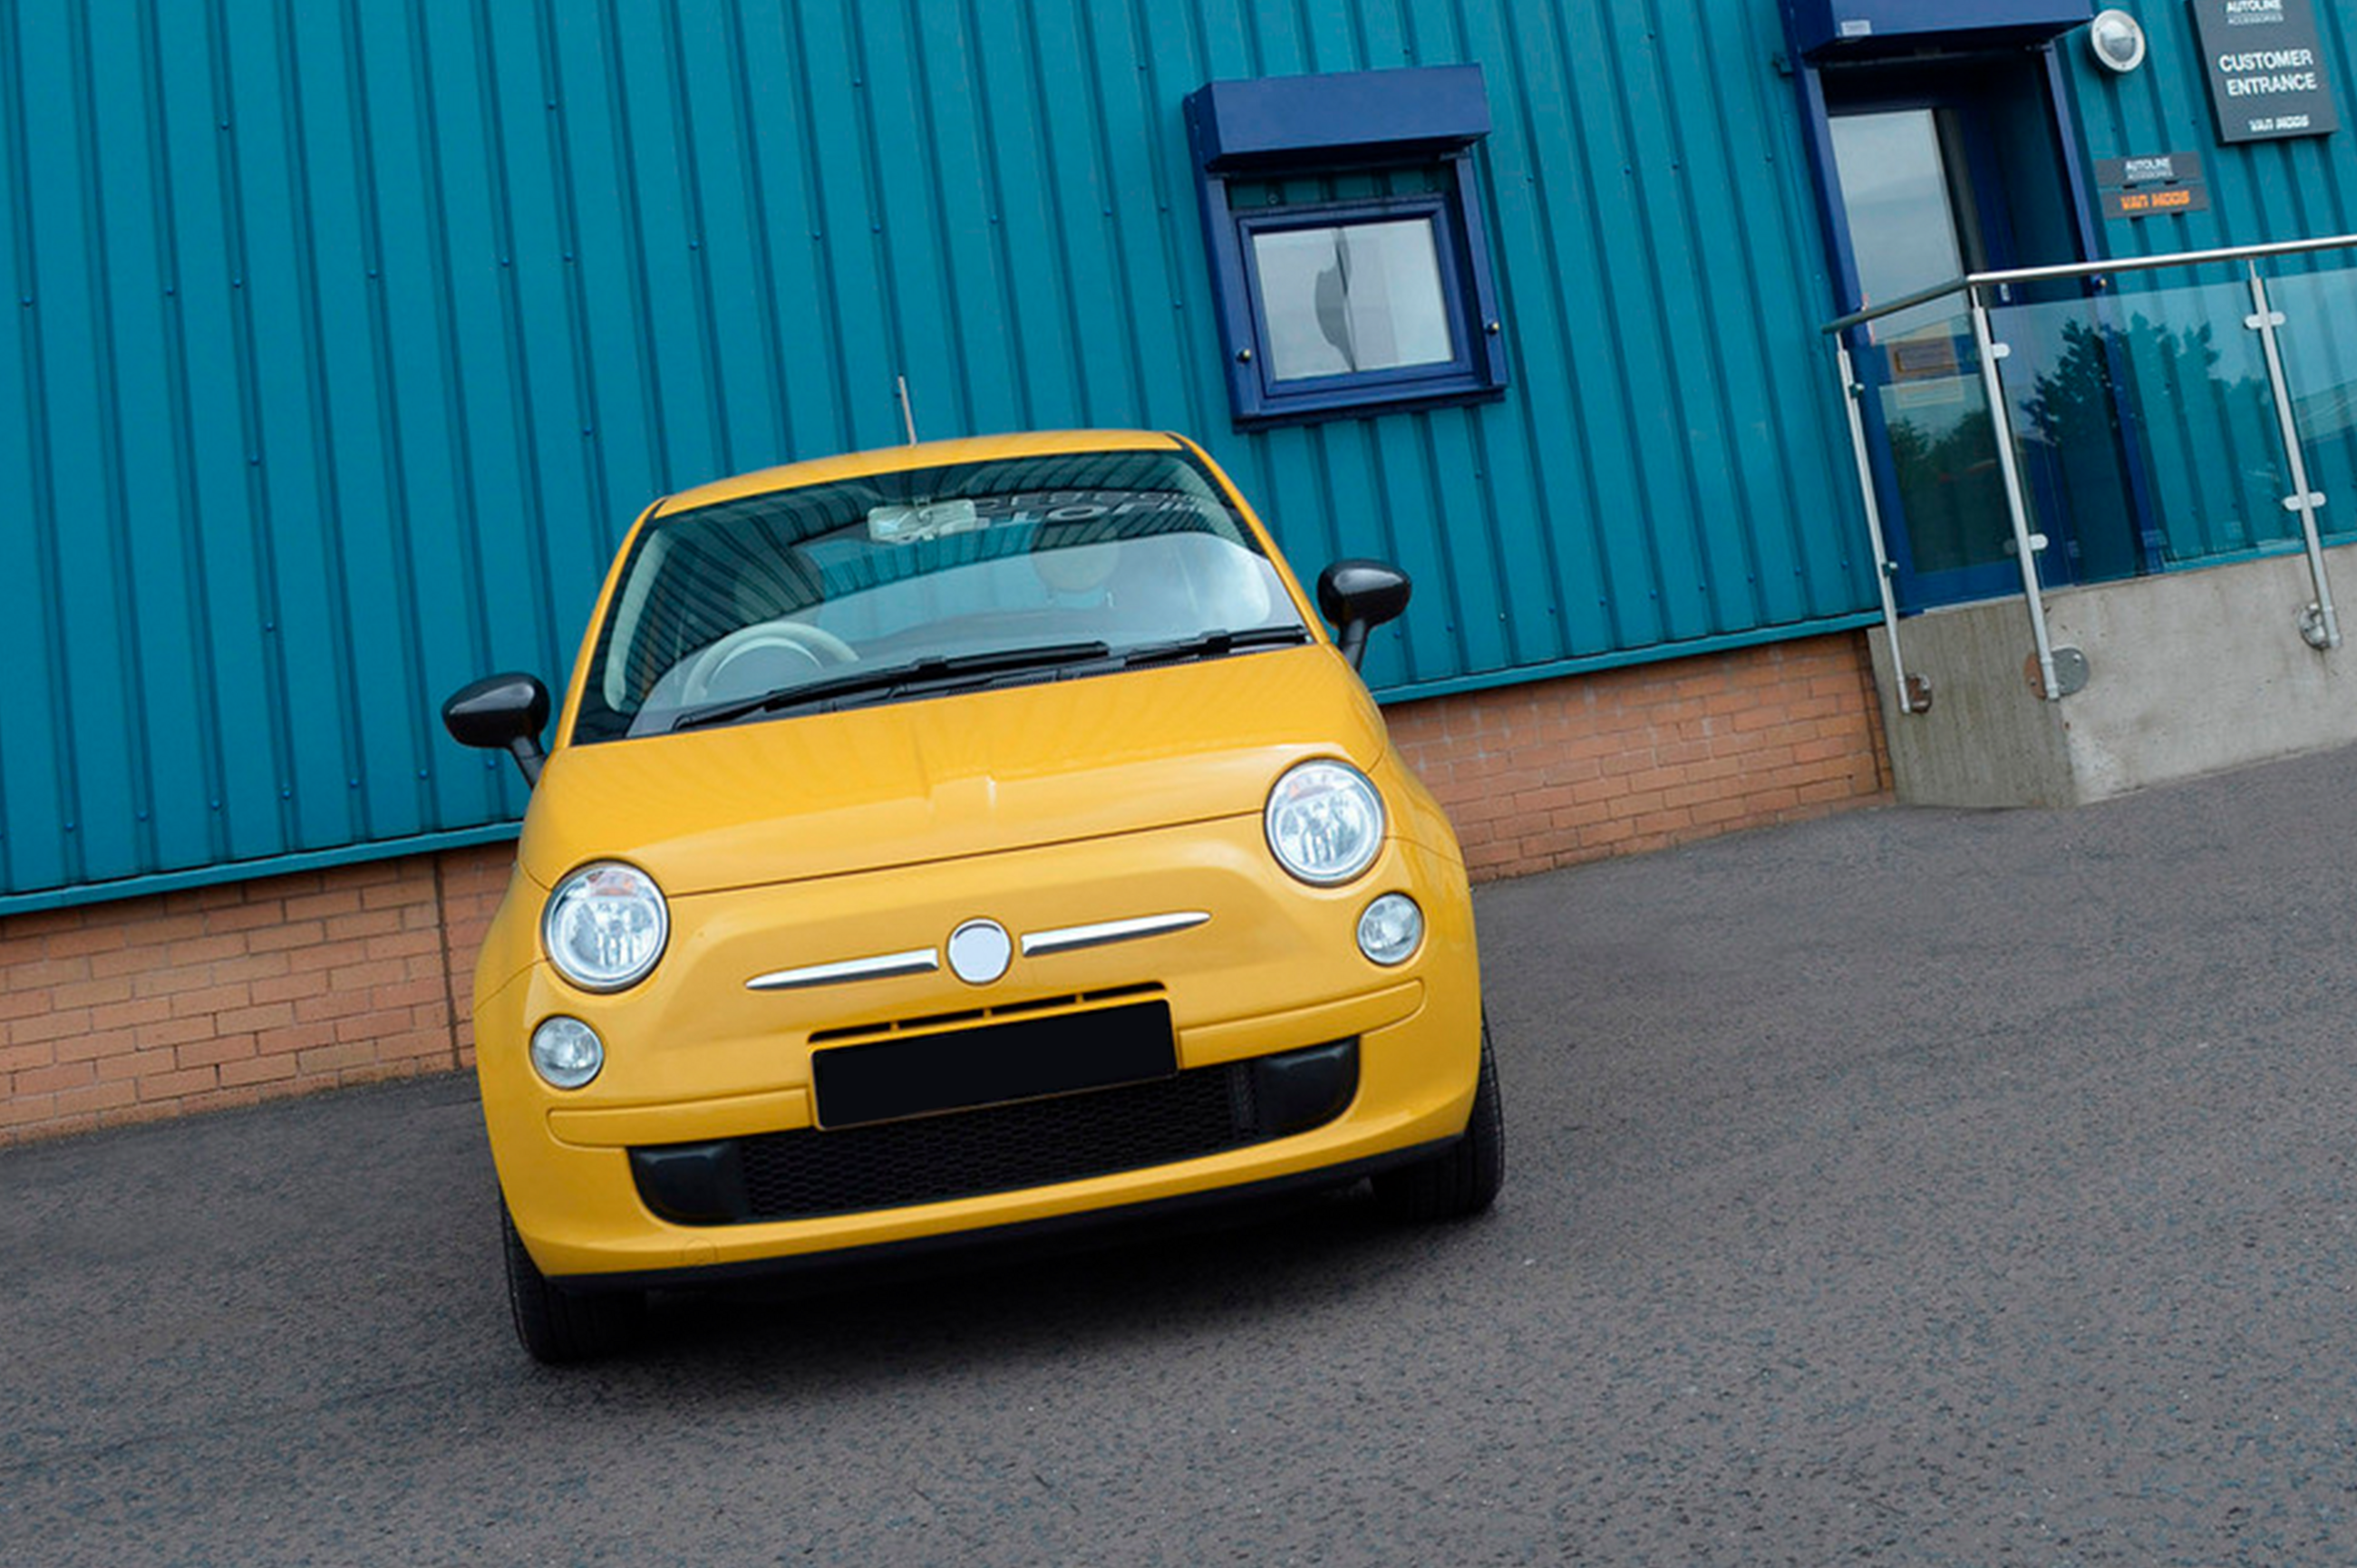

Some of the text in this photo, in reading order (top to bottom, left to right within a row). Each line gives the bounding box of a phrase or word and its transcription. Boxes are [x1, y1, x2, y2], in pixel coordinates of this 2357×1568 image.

[2226, 0, 2283, 13] AUTOLINE
[2218, 49, 2313, 73] CUSTOMER
[2226, 73, 2317, 97] ENTRANCE
[2125, 157, 2171, 172] AUTOLINE
